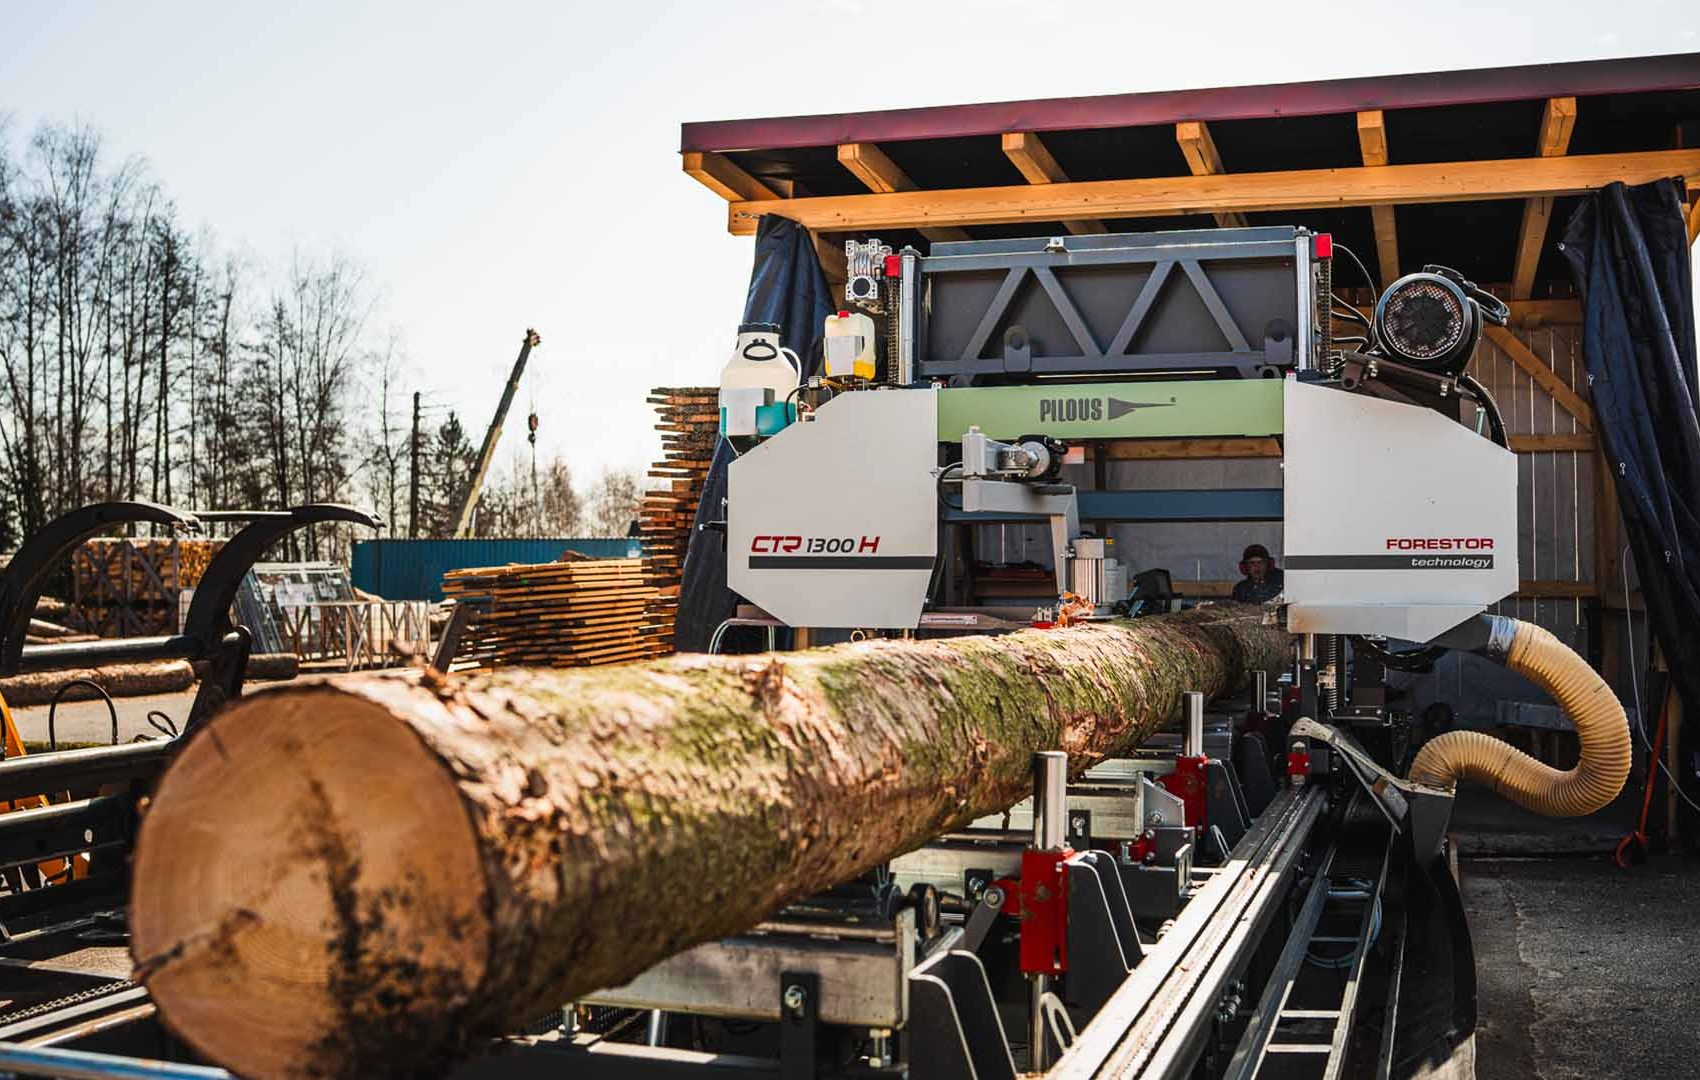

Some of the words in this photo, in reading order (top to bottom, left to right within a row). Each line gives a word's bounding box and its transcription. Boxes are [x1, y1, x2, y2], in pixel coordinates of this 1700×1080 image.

[1040, 397, 1103, 422] PILOUS
[751, 535, 803, 553] CTR
[806, 537, 856, 553] 1300
[858, 535, 881, 553] H
[1386, 538, 1495, 550] FORESTOR
[1411, 556, 1491, 568] technology
